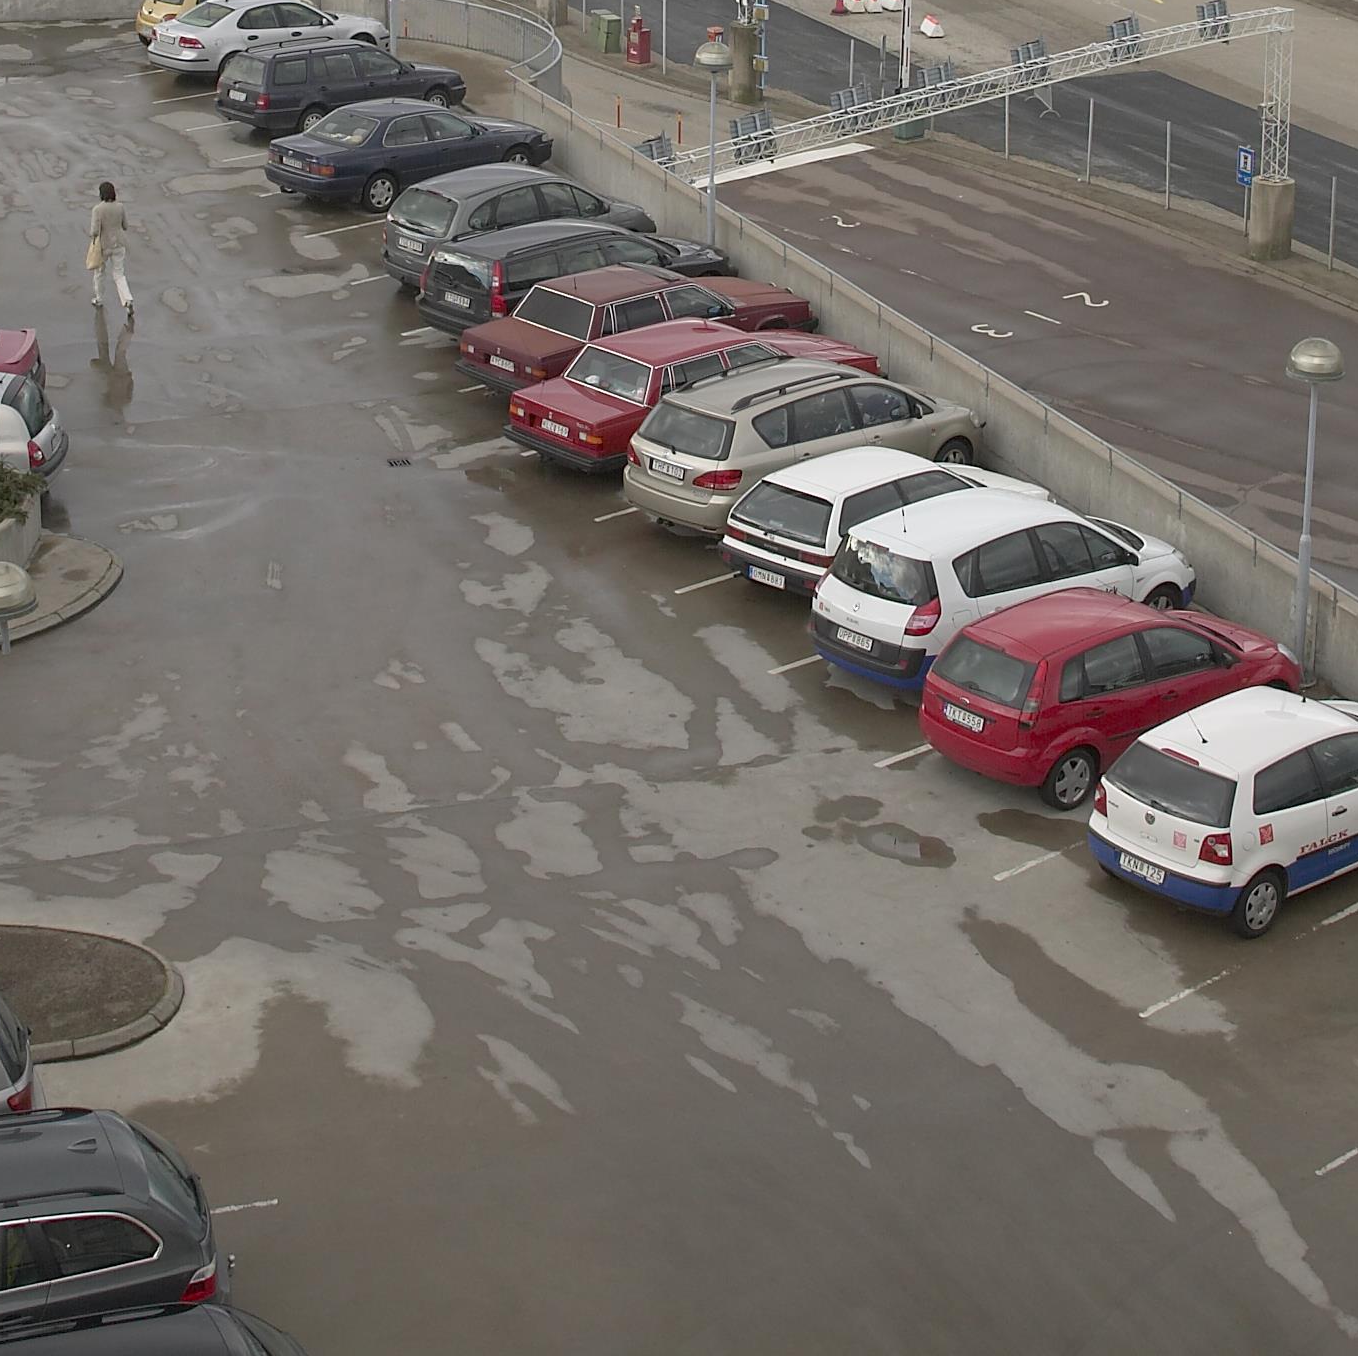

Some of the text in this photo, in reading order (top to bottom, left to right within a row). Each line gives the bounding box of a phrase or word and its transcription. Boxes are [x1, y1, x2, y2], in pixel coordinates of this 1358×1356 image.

[1299, 828, 1348, 854] FALCK
[1123, 853, 1162, 881] TKN 125
